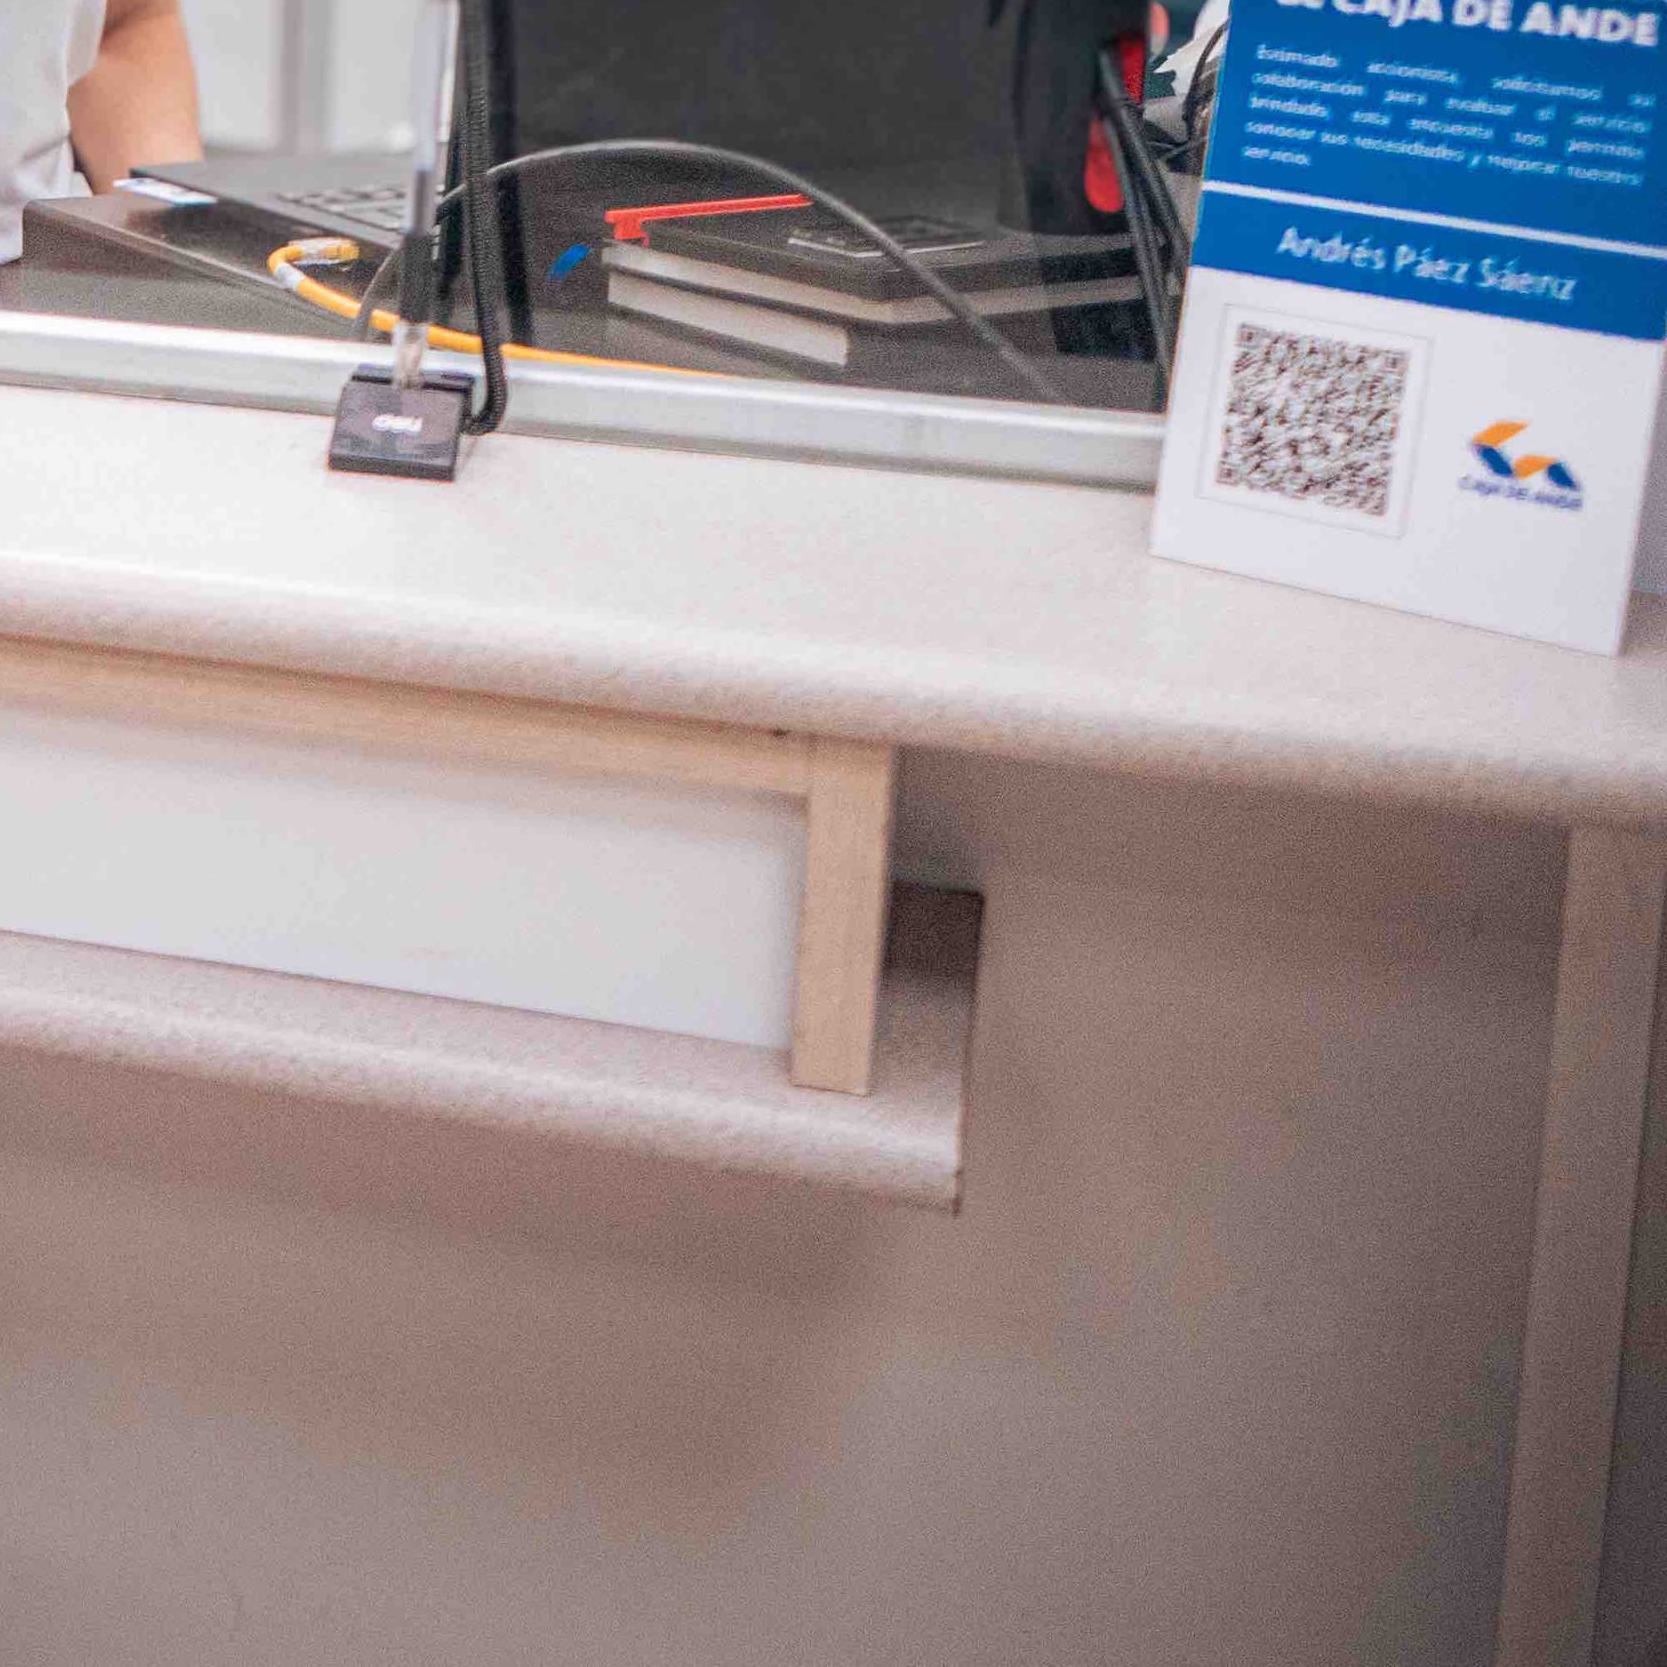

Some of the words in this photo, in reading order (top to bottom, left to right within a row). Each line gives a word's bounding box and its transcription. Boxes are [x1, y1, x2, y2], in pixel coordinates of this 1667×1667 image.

[1519, 1, 1660, 48] ANDE
[1275, 226, 1387, 270] Andrés
[1394, 244, 1471, 283] Páez
[1477, 255, 1579, 301] Sáenz
